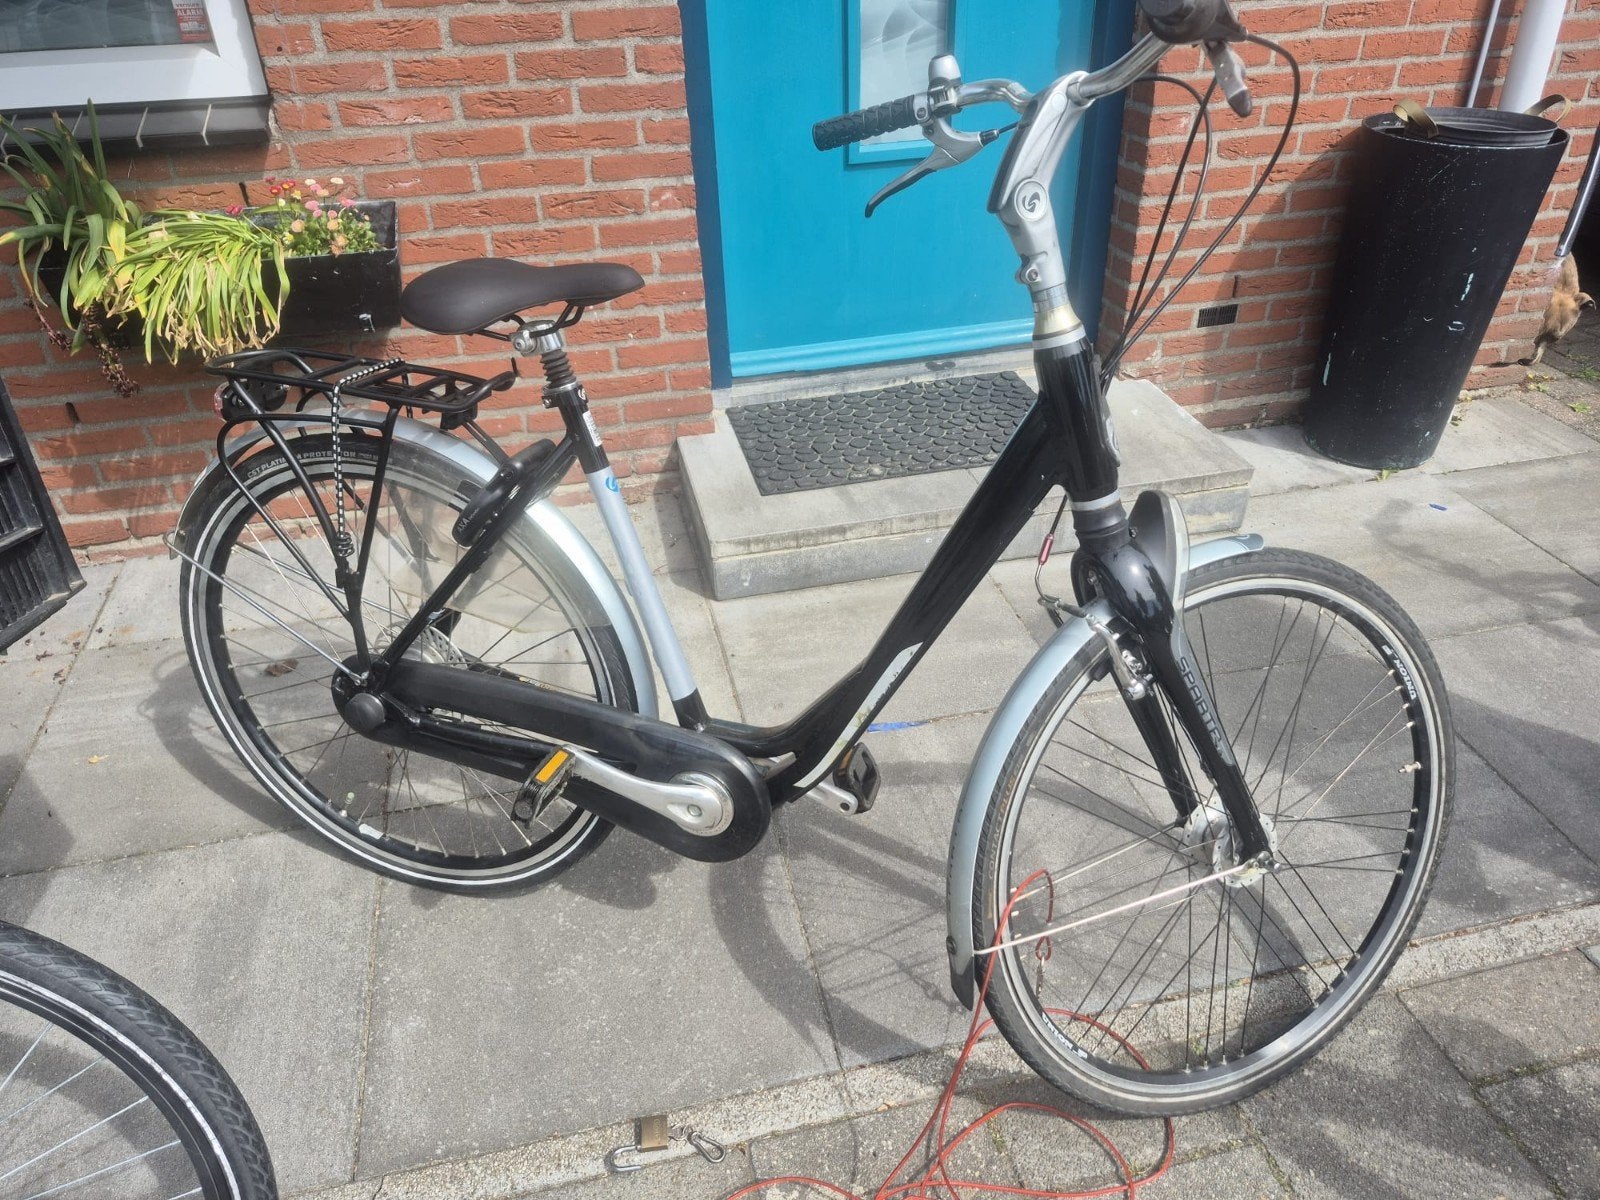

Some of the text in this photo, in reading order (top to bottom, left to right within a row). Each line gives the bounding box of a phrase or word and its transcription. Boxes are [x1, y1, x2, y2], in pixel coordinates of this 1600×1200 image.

[303, 451, 356, 459] PROTEOR
[1394, 659, 1417, 700] UNION
[1180, 656, 1222, 746] SPARTA
